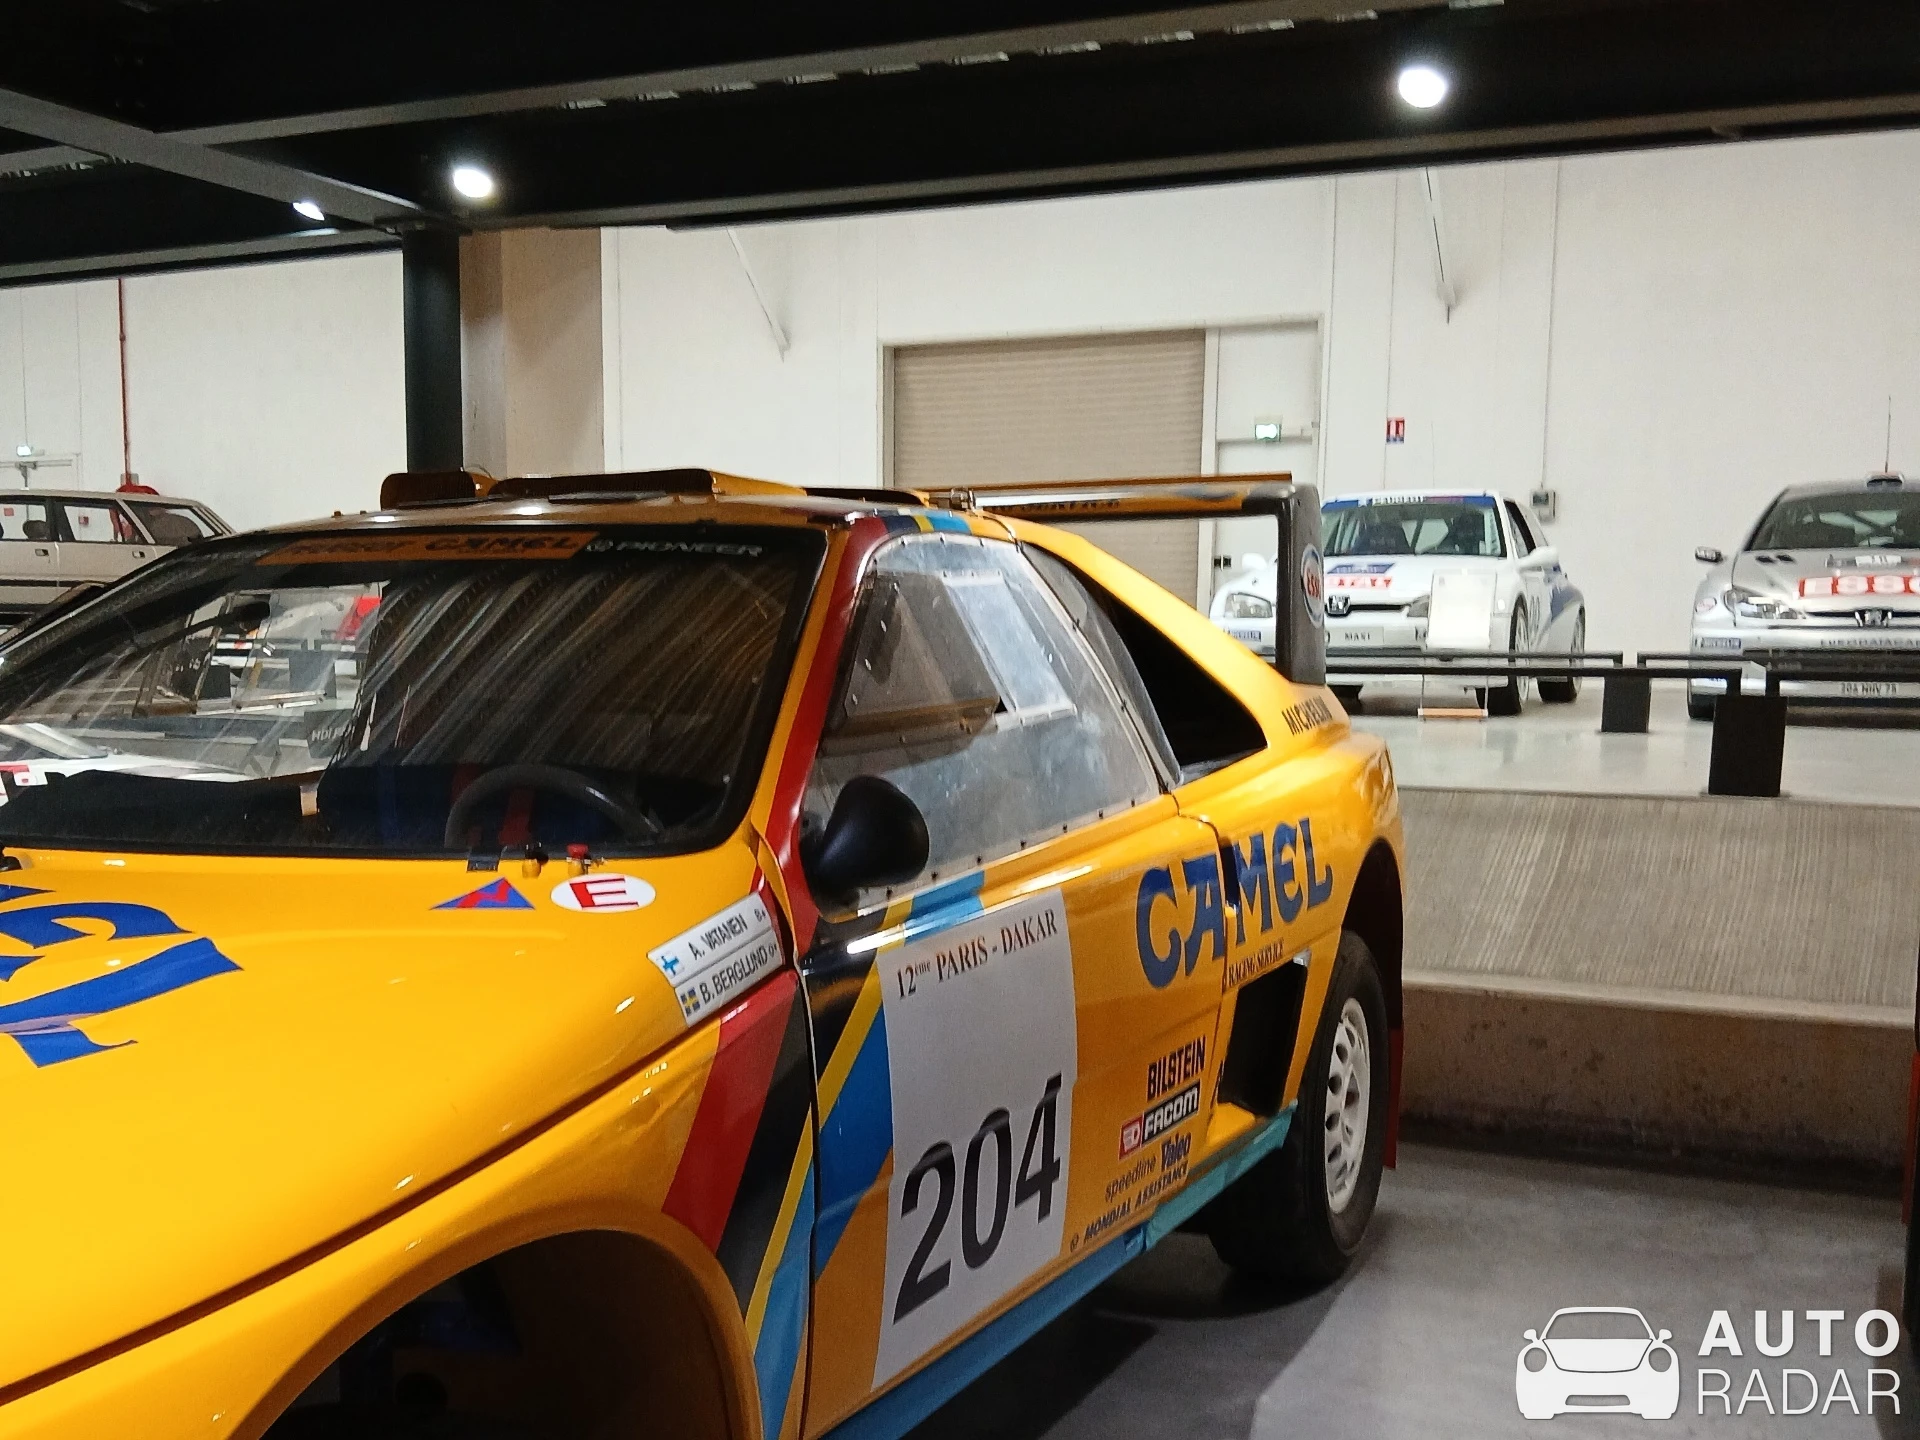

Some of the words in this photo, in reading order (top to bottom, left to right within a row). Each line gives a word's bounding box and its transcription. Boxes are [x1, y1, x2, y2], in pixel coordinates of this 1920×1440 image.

[425, 536, 580, 551] CAMEL
[617, 541, 763, 556] PIONEER
[1281, 695, 1333, 737] MICHELIN
[570, 877, 640, 908] E
[1136, 817, 1334, 989] CAMEL
[688, 941, 706, 960] A.
[700, 912, 748, 951] VATANEN
[936, 935, 989, 983] PARIS
[1001, 909, 1058, 957] DAKAR
[699, 982, 715, 1004] B.
[712, 945, 768, 996] BERGLUND
[1146, 1035, 1206, 1102] BILSTEIN
[1144, 1086, 1199, 1141] FACOM
[1105, 1155, 1157, 1203] speedline
[1161, 1132, 1192, 1172] Valeo
[893, 1071, 1062, 1326] 204
[1084, 1197, 1131, 1244] MONDIAL
[1135, 1160, 1189, 1209] ASSISTANCE
